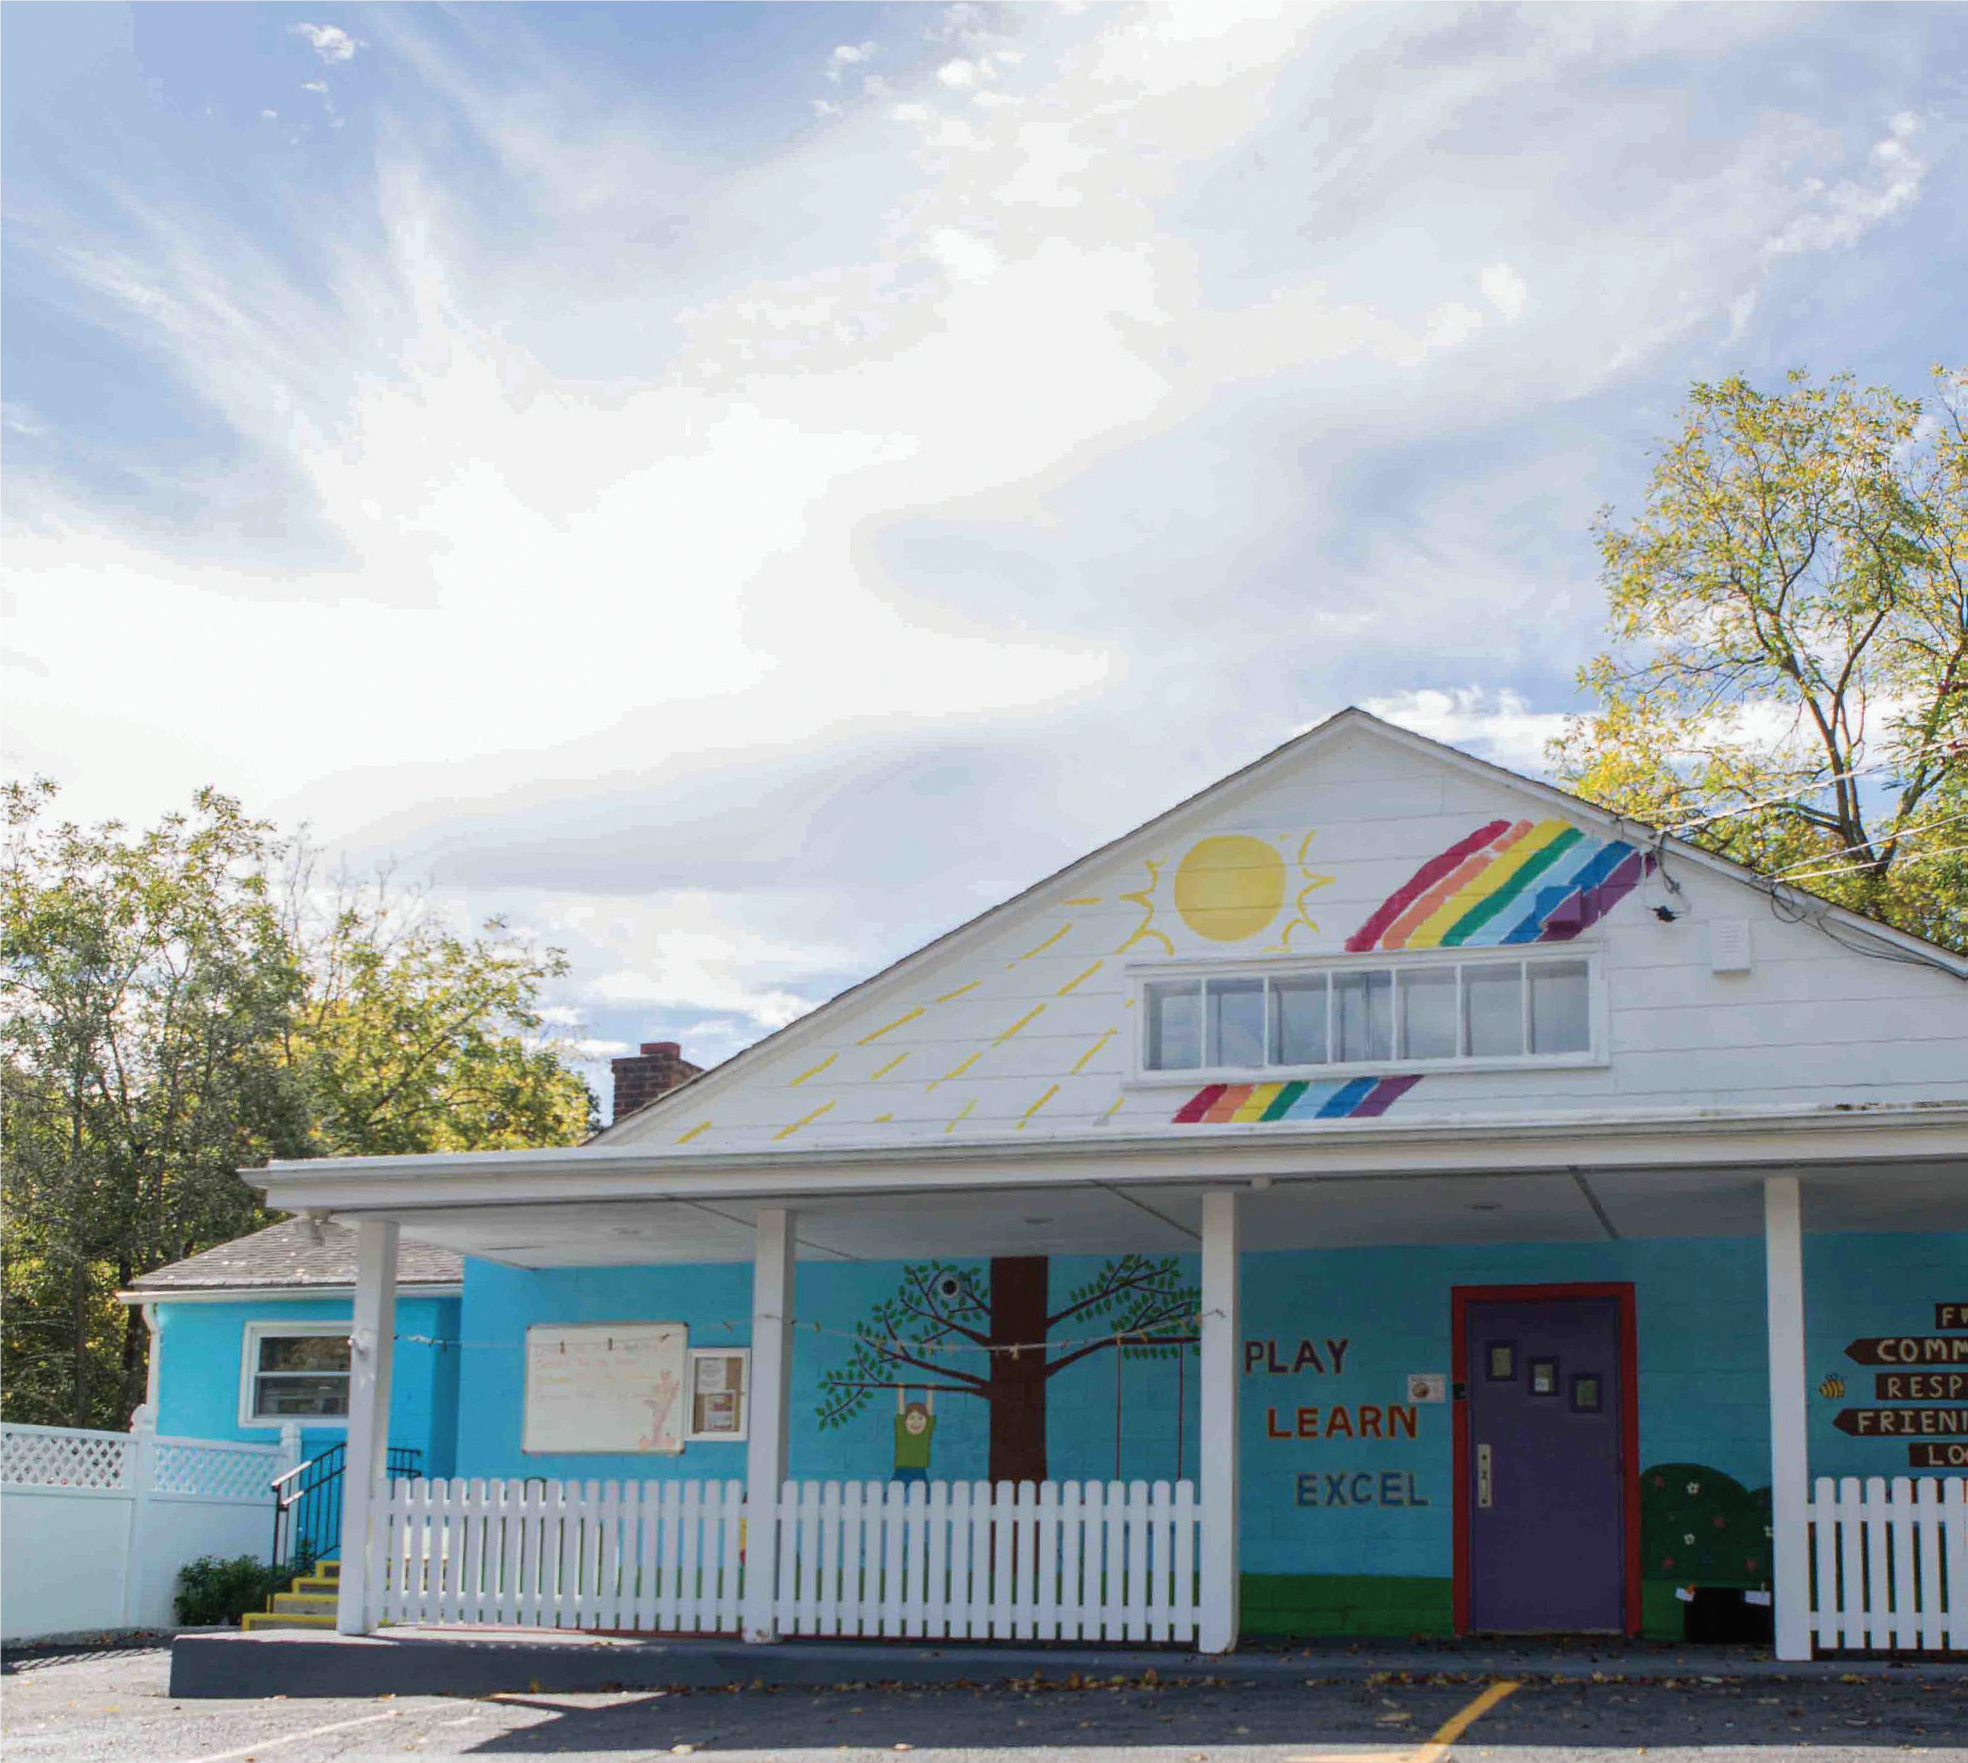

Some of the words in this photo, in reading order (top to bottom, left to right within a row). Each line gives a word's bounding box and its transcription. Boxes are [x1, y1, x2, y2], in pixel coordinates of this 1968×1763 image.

[1243, 1338, 1350, 1375] PLAY
[1887, 1375, 1963, 1399] RESP
[1265, 1403, 1419, 1440] LEARN
[1857, 1410, 1968, 1434] FRIEN
[1296, 1470, 1430, 1508] EXCEL
